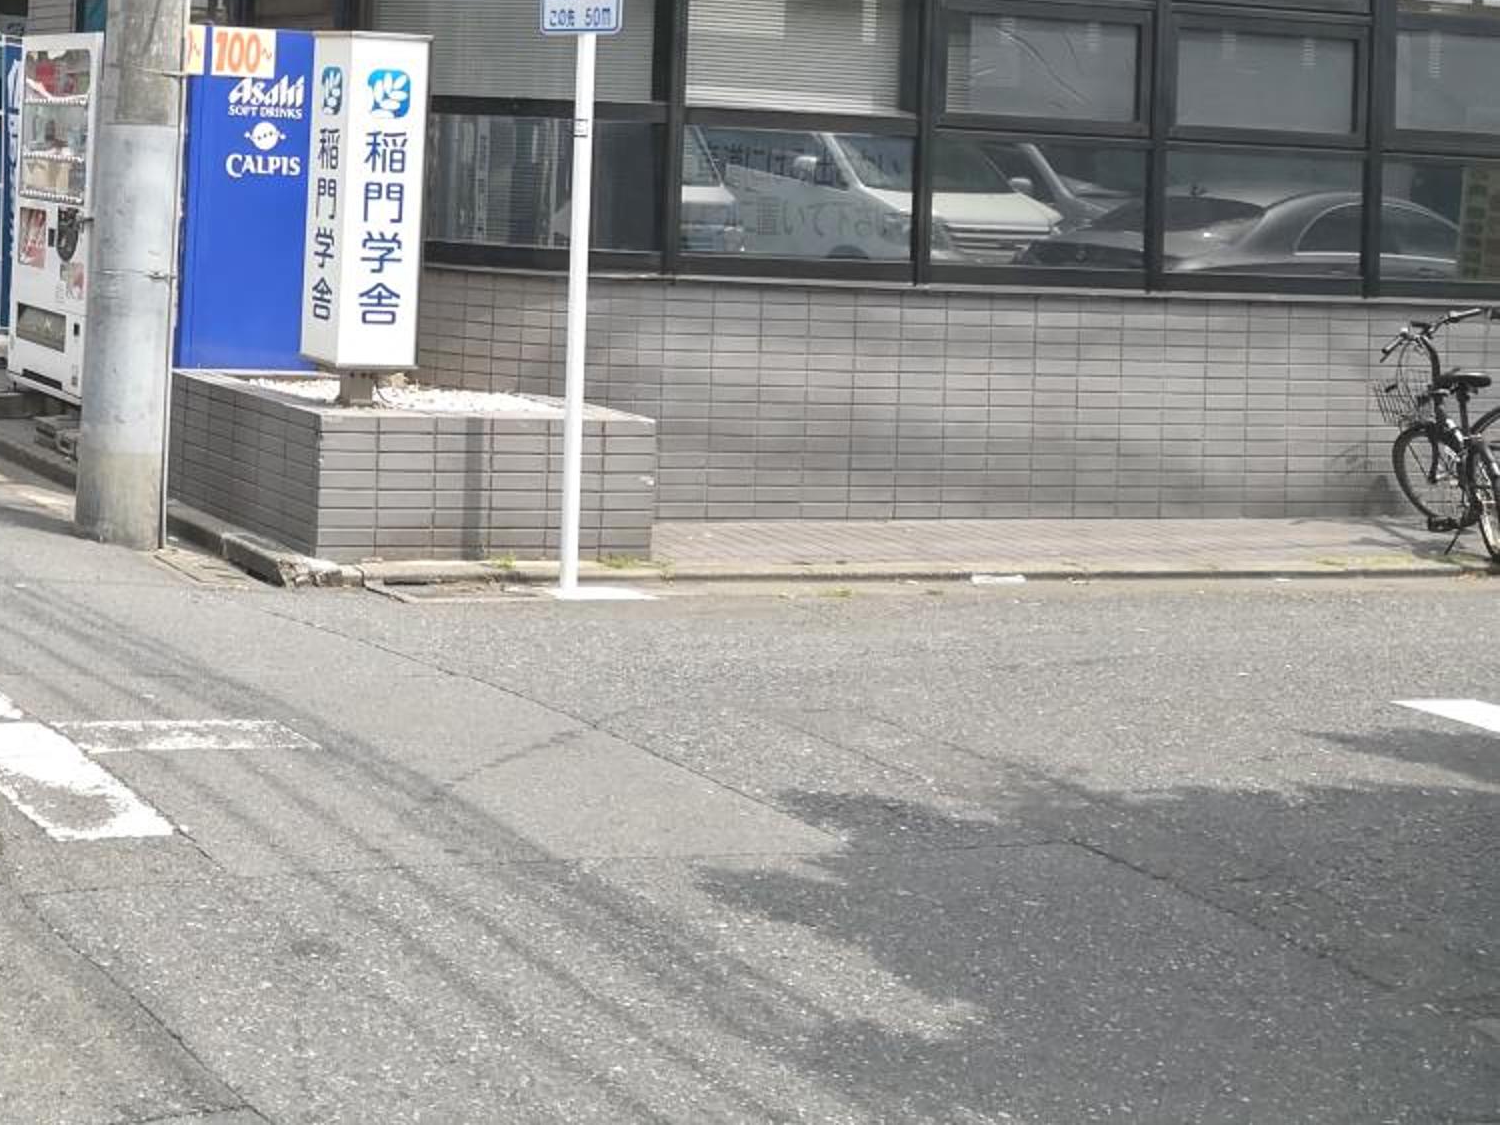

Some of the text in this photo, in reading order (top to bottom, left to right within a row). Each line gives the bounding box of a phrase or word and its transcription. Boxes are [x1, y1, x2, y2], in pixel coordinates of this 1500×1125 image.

[228, 74, 305, 108] Asahi
[228, 104, 303, 119] SOFT DRINKS
[226, 153, 301, 178] CALPIS
[312, 127, 340, 321] 稲門学舎
[358, 130, 408, 325] 稲門学舎
